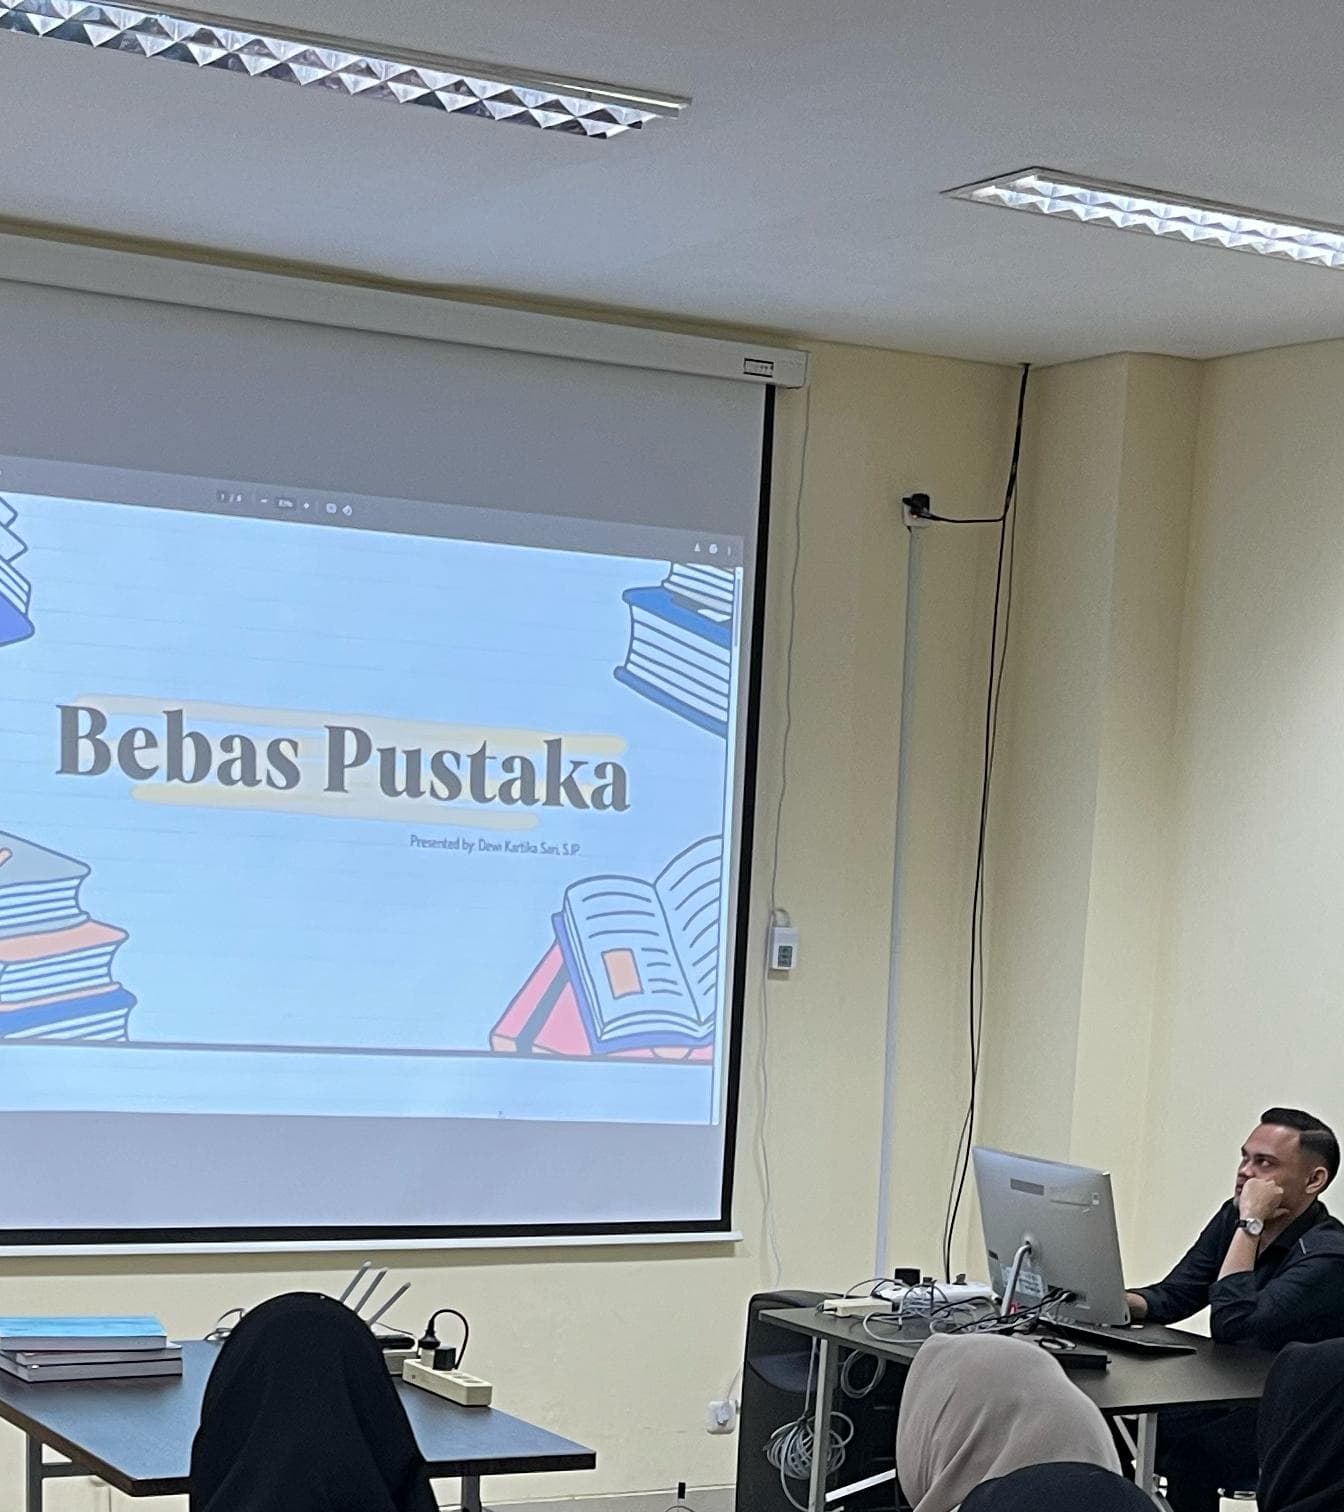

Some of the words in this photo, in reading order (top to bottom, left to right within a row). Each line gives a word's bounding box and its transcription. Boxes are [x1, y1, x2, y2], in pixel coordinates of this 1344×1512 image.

[55, 704, 301, 792] Bebas
[323, 724, 631, 813] Pustaka
[410, 834, 460, 850] Presented
[504, 840, 538, 854] Kartika
